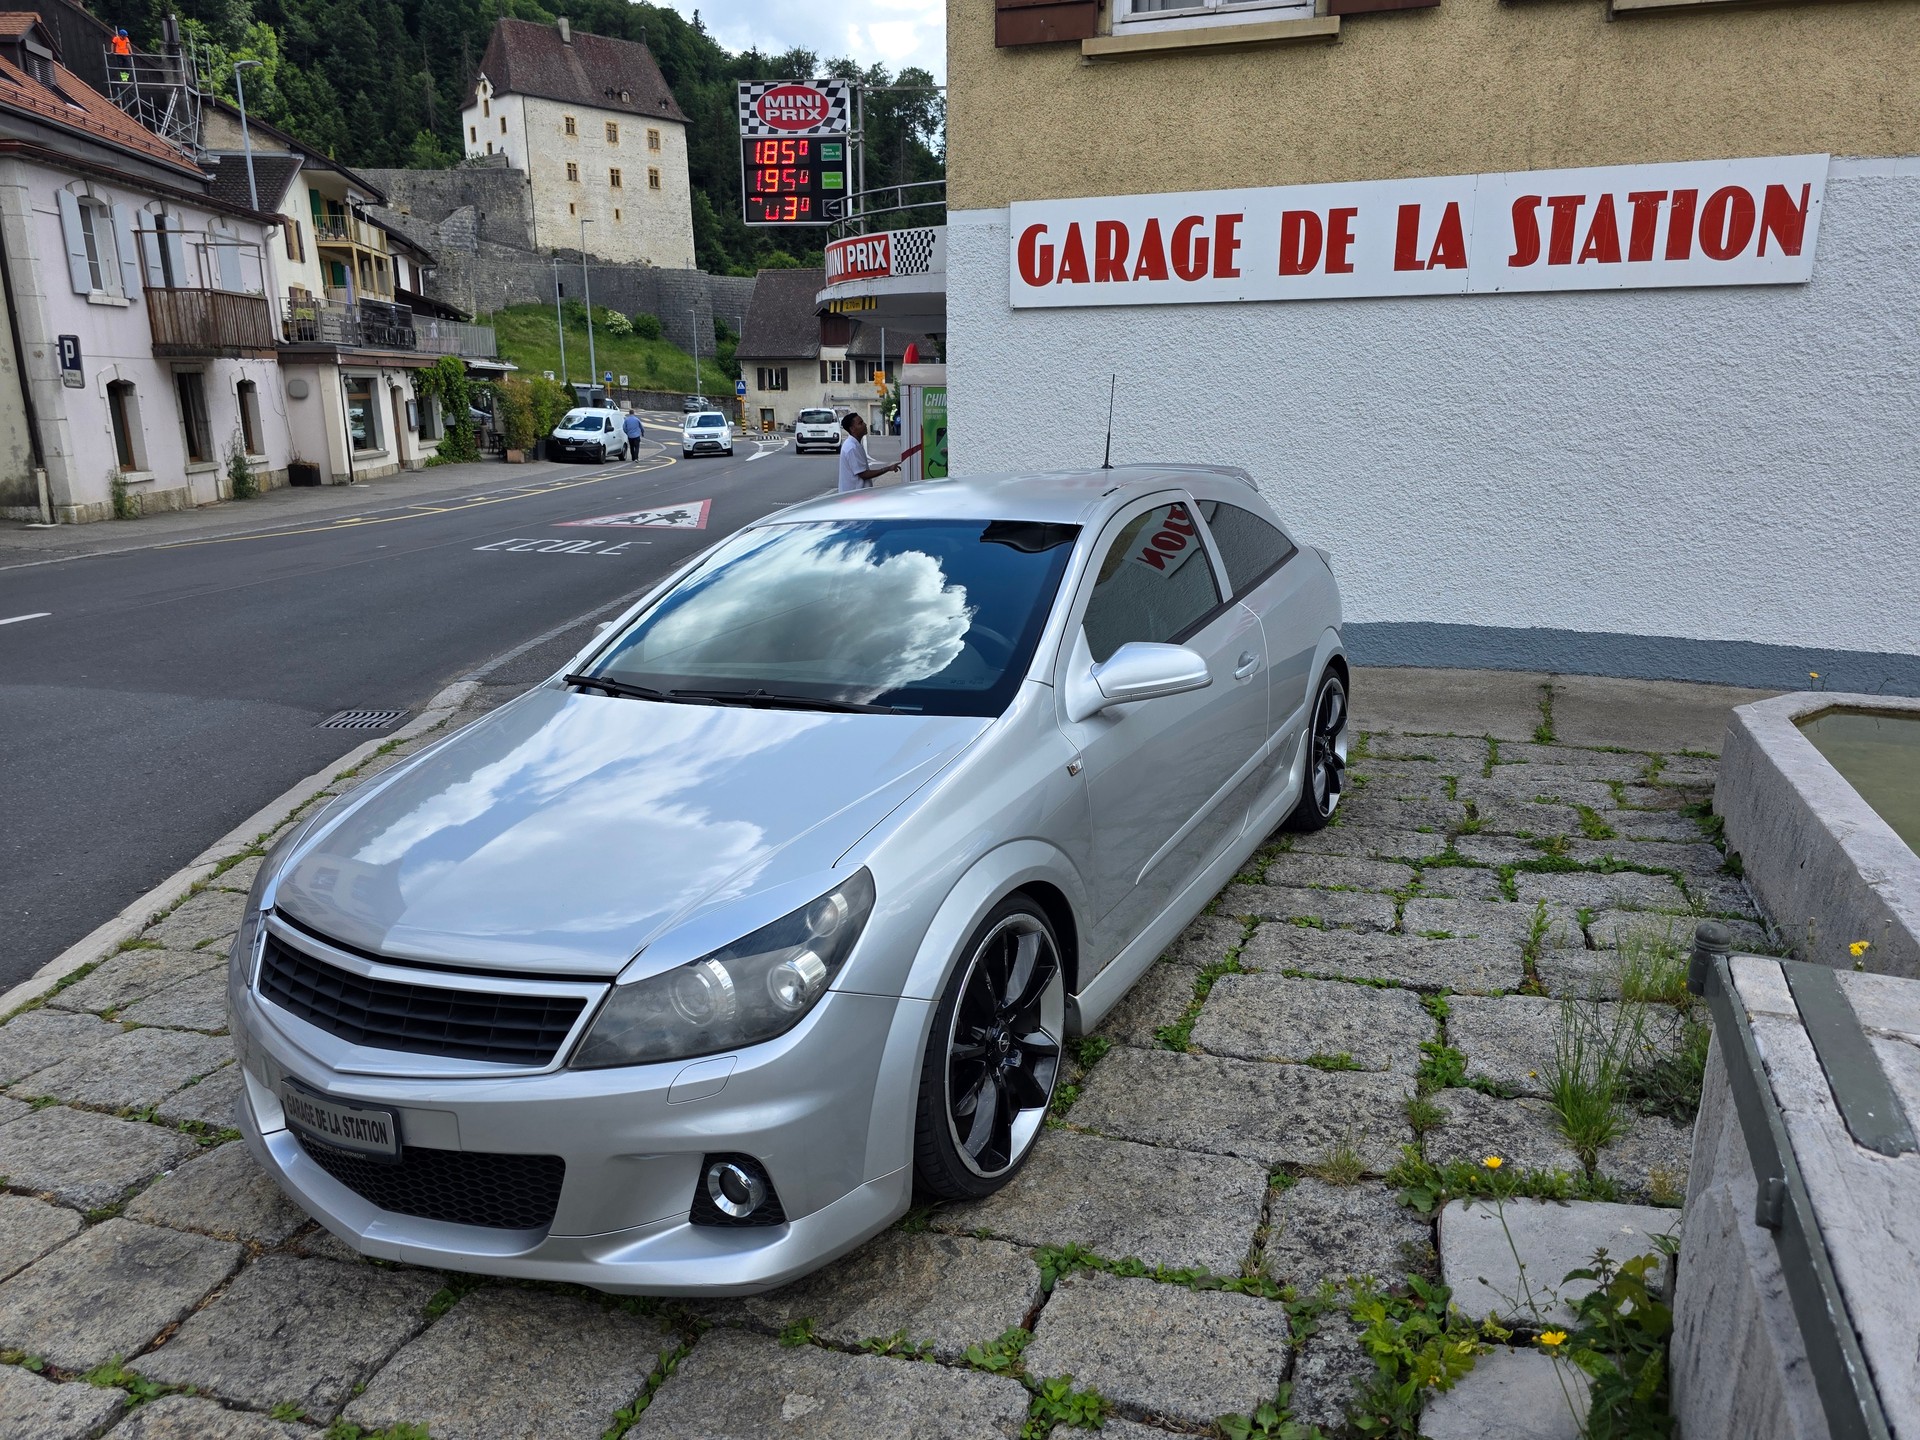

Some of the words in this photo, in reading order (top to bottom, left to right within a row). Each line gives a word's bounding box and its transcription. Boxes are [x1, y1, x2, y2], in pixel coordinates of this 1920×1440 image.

[764, 95, 821, 108] MINI
[765, 108, 822, 121] PRIX
[1017, 214, 1244, 286] GARAGE
[1279, 207, 1358, 276] DE
[1394, 202, 1467, 271] LA
[1508, 183, 1811, 267] STATION
[846, 240, 888, 273] PRIX
[64, 340, 75, 367] P
[472, 538, 652, 555] ECOLE
[286, 1094, 315, 1127] GARAGE
[315, 1107, 329, 1132] DE
[327, 1111, 342, 1136] LA
[342, 1116, 388, 1145] STATION
